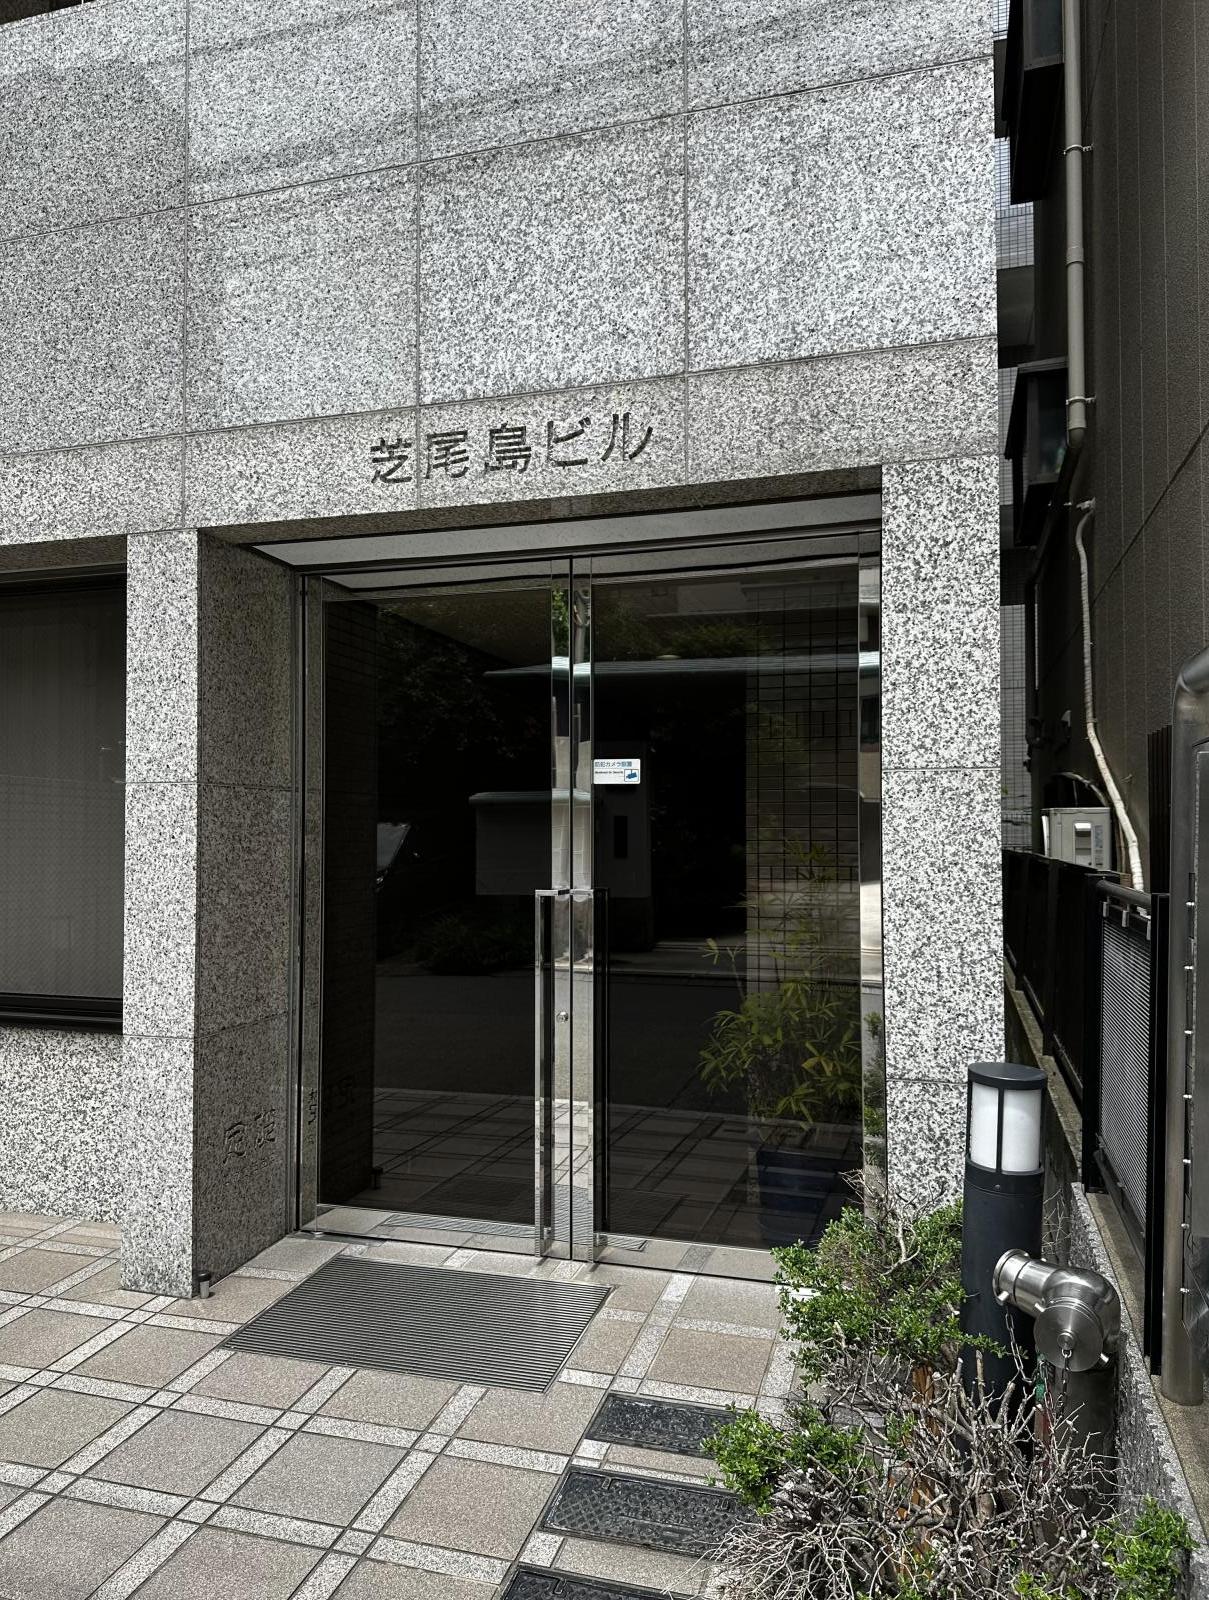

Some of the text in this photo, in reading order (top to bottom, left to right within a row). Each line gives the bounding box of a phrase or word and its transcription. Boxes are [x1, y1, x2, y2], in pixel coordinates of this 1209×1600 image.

[371, 412, 653, 484] 芝尾島ビル
